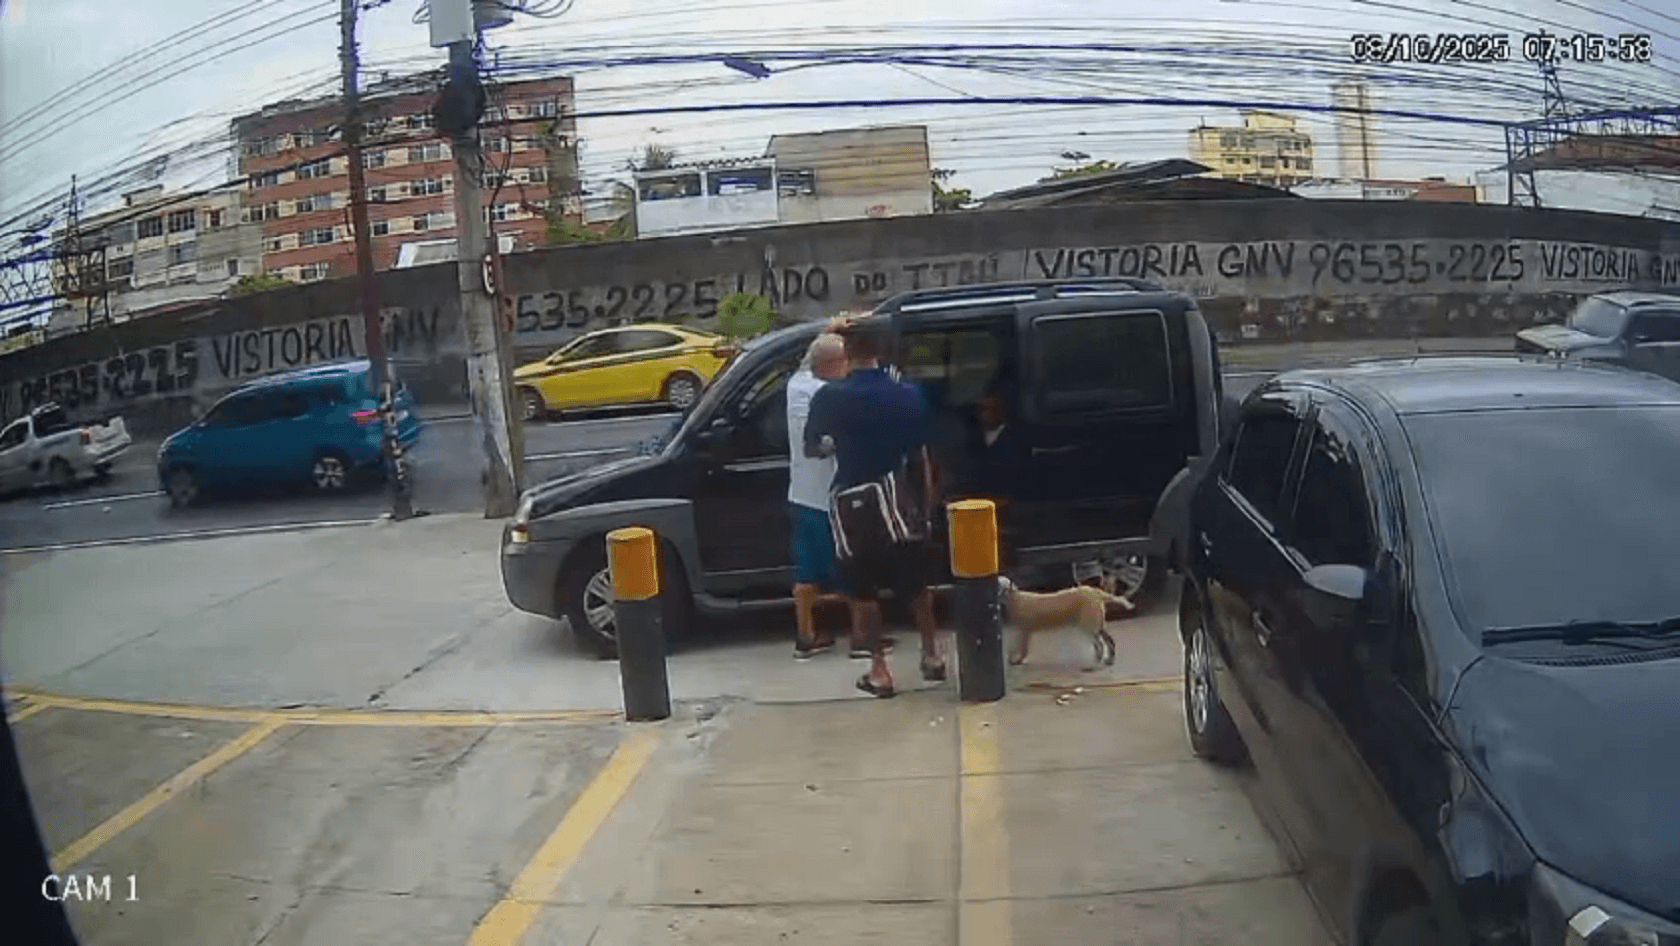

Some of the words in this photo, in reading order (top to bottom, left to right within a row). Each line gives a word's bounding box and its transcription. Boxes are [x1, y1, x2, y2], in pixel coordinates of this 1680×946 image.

[1035, 245, 1203, 279] VISTORIA
[1217, 242, 1295, 278] GNV
[1541, 244, 1639, 281] VISTORIA
[1651, 254, 1680, 286] GN
[212, 317, 356, 378] VISTORIA
